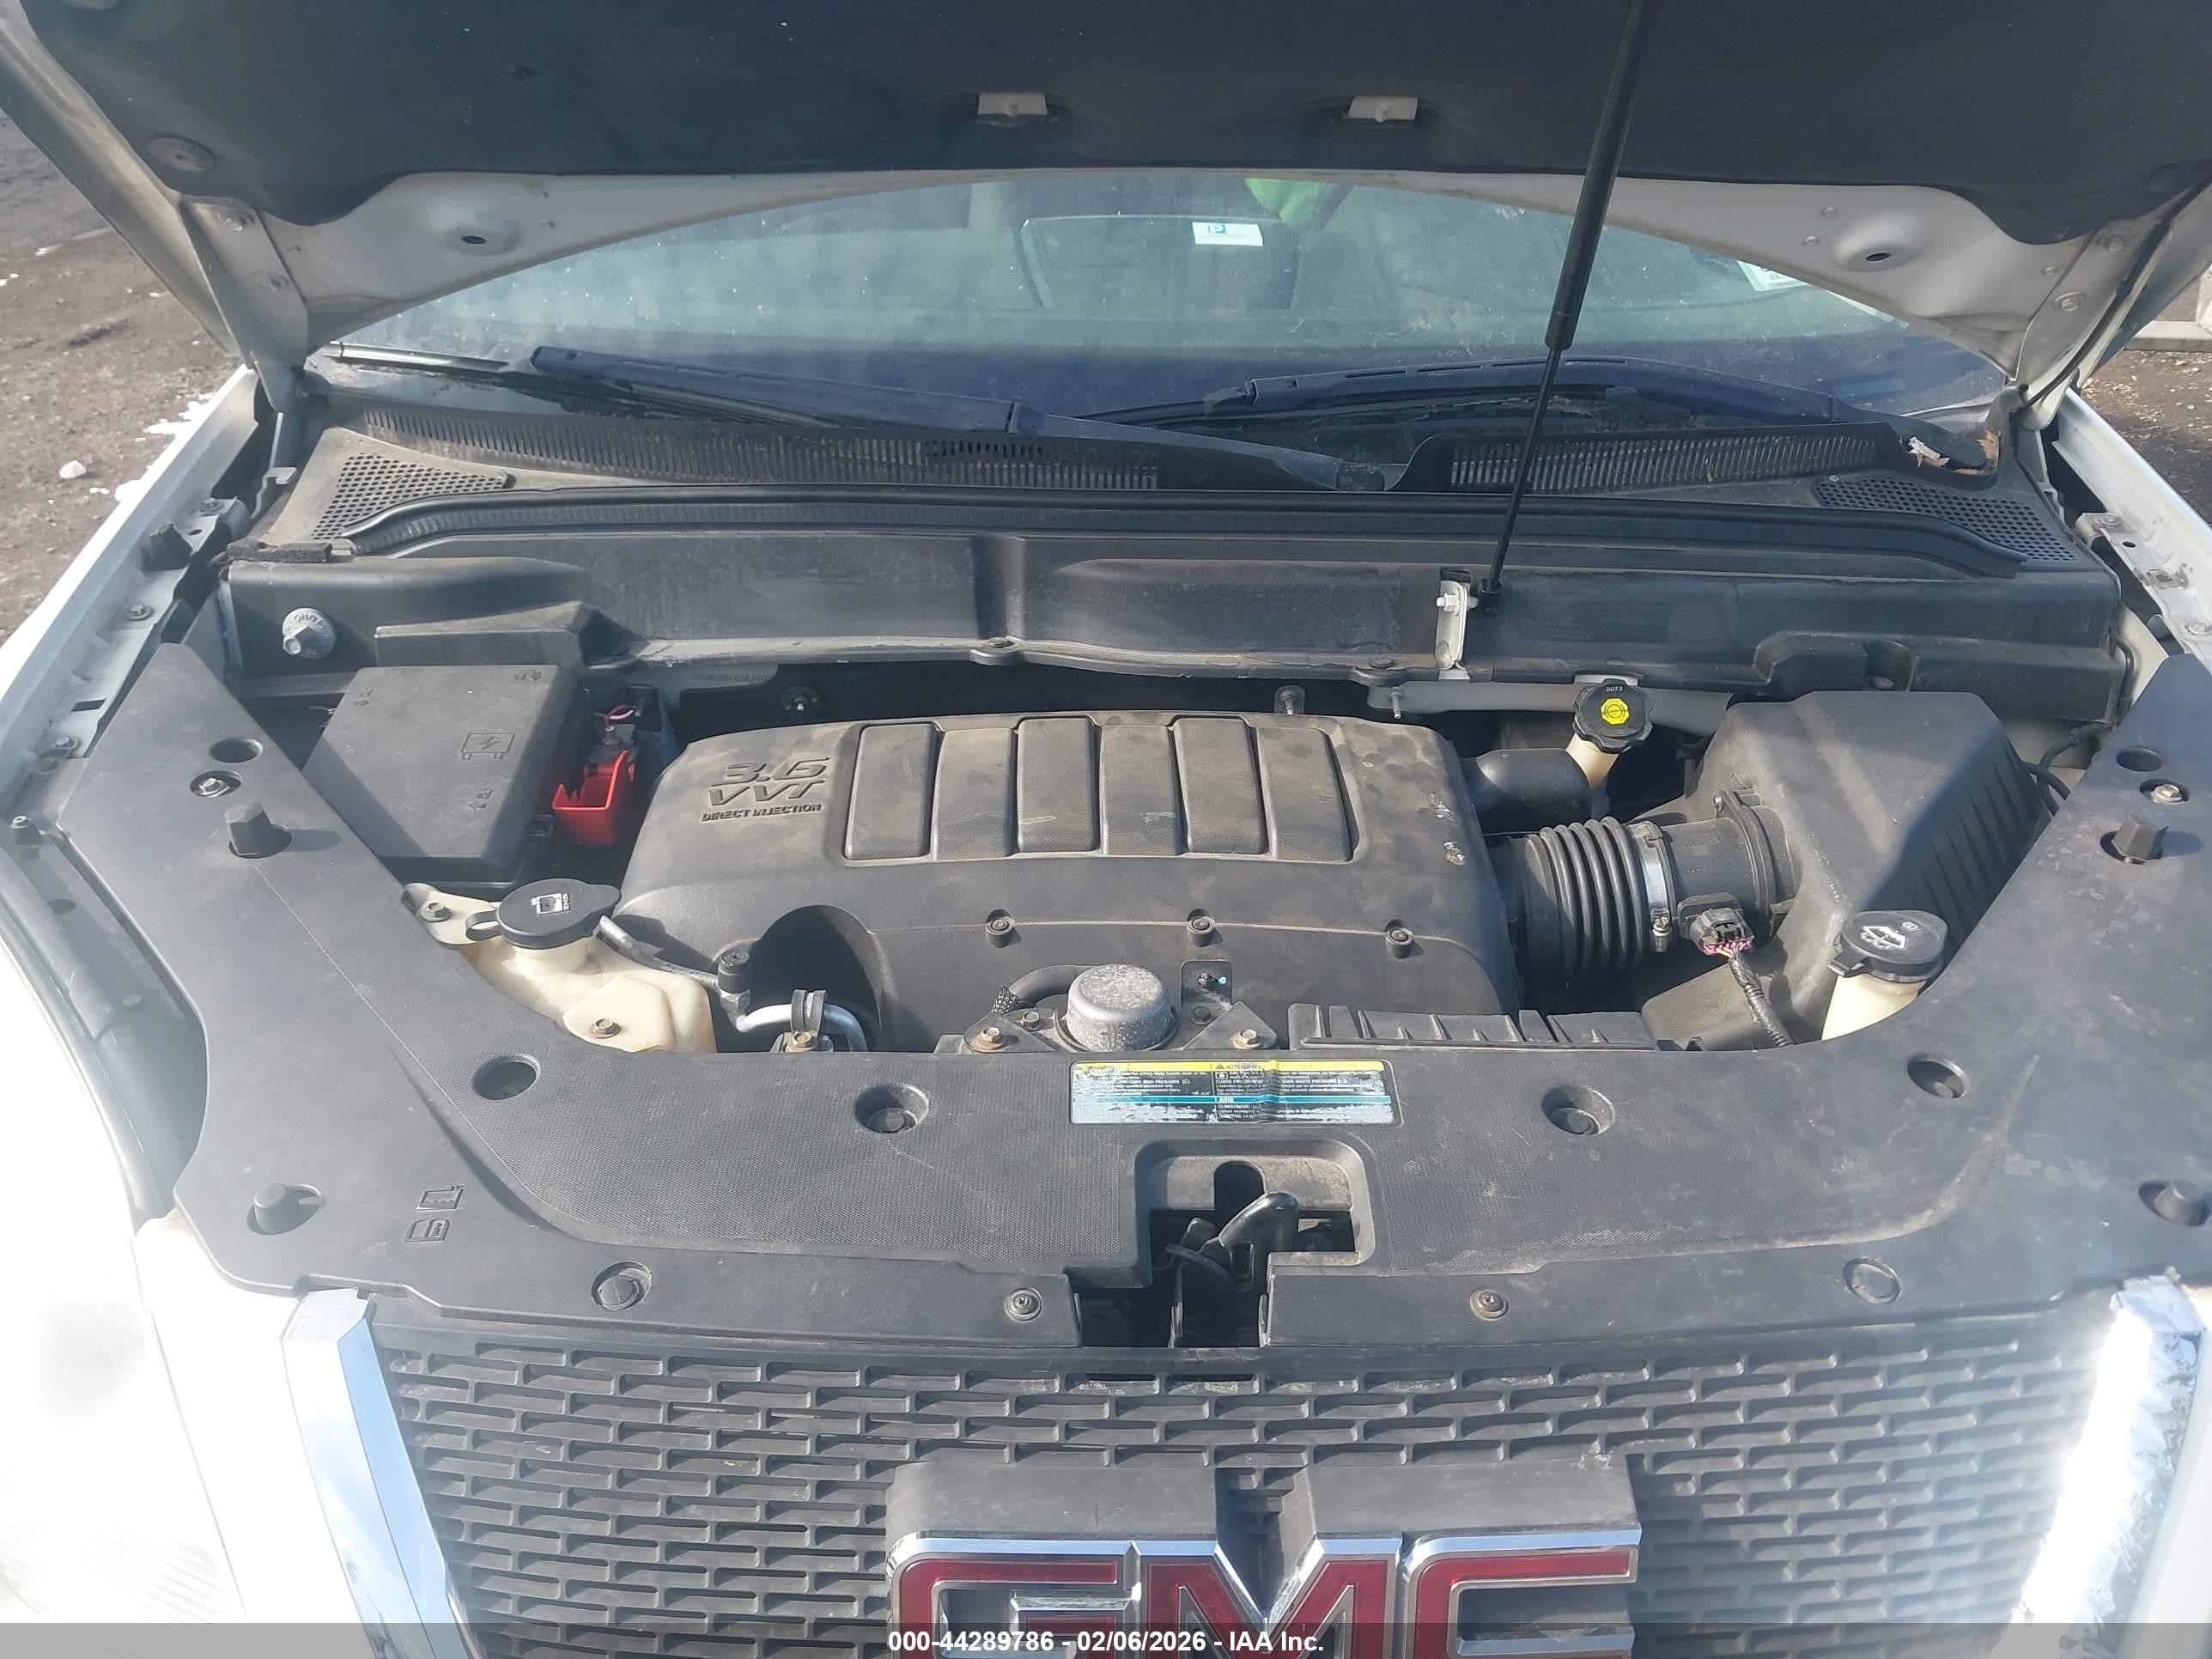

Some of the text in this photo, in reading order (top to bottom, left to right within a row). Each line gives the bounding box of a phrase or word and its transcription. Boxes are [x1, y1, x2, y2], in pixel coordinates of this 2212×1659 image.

[711, 757, 830, 787] 3.6
[708, 779, 827, 806] VVT
[701, 803, 823, 823] DIRECT INJECTION
[885, 1533, 1642, 1659] GMC
